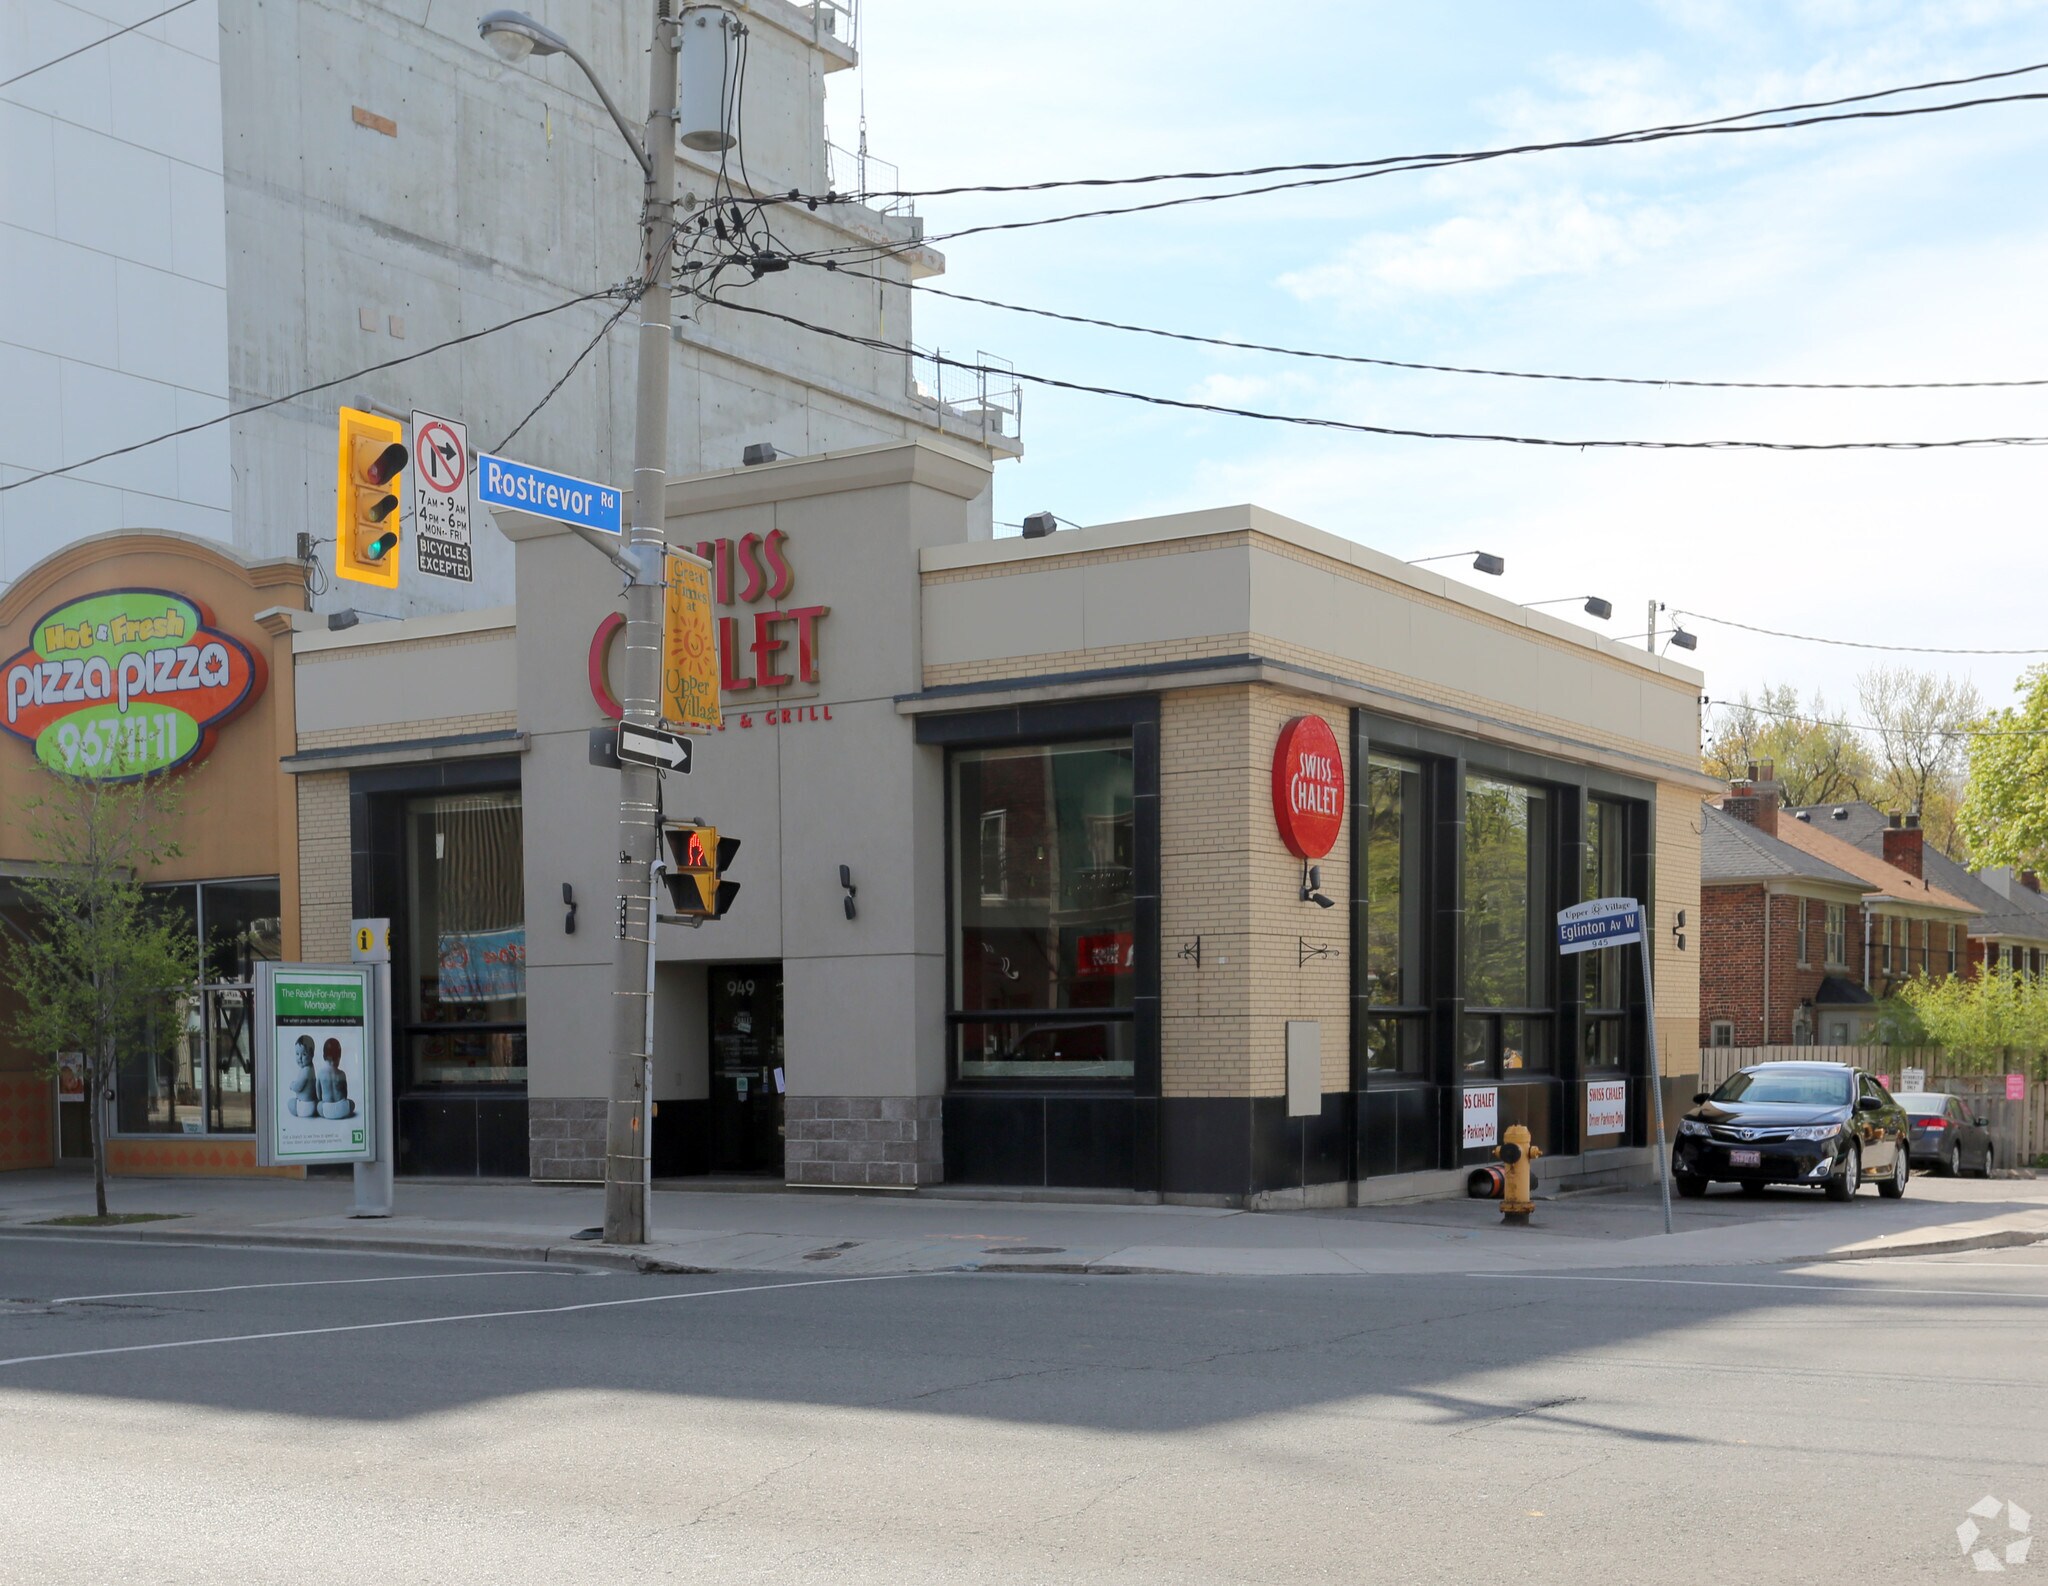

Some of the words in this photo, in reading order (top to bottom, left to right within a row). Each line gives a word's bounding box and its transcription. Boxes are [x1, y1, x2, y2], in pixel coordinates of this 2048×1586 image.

[488, 462, 592, 516] Rostrevor
[601, 491, 614, 509] Rd
[450, 530, 462, 540] FRI
[420, 539, 469, 561] BICYCLES
[420, 555, 471, 578] EXCEPTED
[674, 560, 704, 586] Great
[690, 529, 795, 605] ISS
[672, 578, 707, 604] Times
[687, 602, 696, 612] at
[44, 620, 94, 654] Hot
[95, 624, 109, 641] &
[110, 607, 185, 646] Fresh
[666, 669, 710, 699] Upper
[674, 695, 719, 724] Village
[740, 714, 752, 728] &
[765, 705, 832, 725] GRILL
[1299, 752, 1332, 782] SWISS
[1291, 773, 1338, 815] CHALET
[1565, 910, 1588, 920] Upper
[1605, 902, 1631, 912] Village
[1561, 921, 1606, 941] Eglinton
[1610, 920, 1621, 932] Av
[1625, 914, 1635, 929] W
[1592, 939, 1609, 948] 945
[281, 988, 295, 998] The
[295, 989, 357, 1000] Ready-For-Anything
[727, 980, 755, 996] 949
[304, 1001, 336, 1012] Mortgage
[1473, 1093, 1495, 1108] CHALET
[1589, 1088, 1604, 1102] SWISS
[1606, 1086, 1624, 1100] CHALET
[1589, 1113, 1600, 1127] Driver
[1601, 1112, 1615, 1128] Parking
[1615, 1111, 1624, 1127] Only
[1467, 1124, 1484, 1142] Parking
[1485, 1123, 1495, 1141] Only
